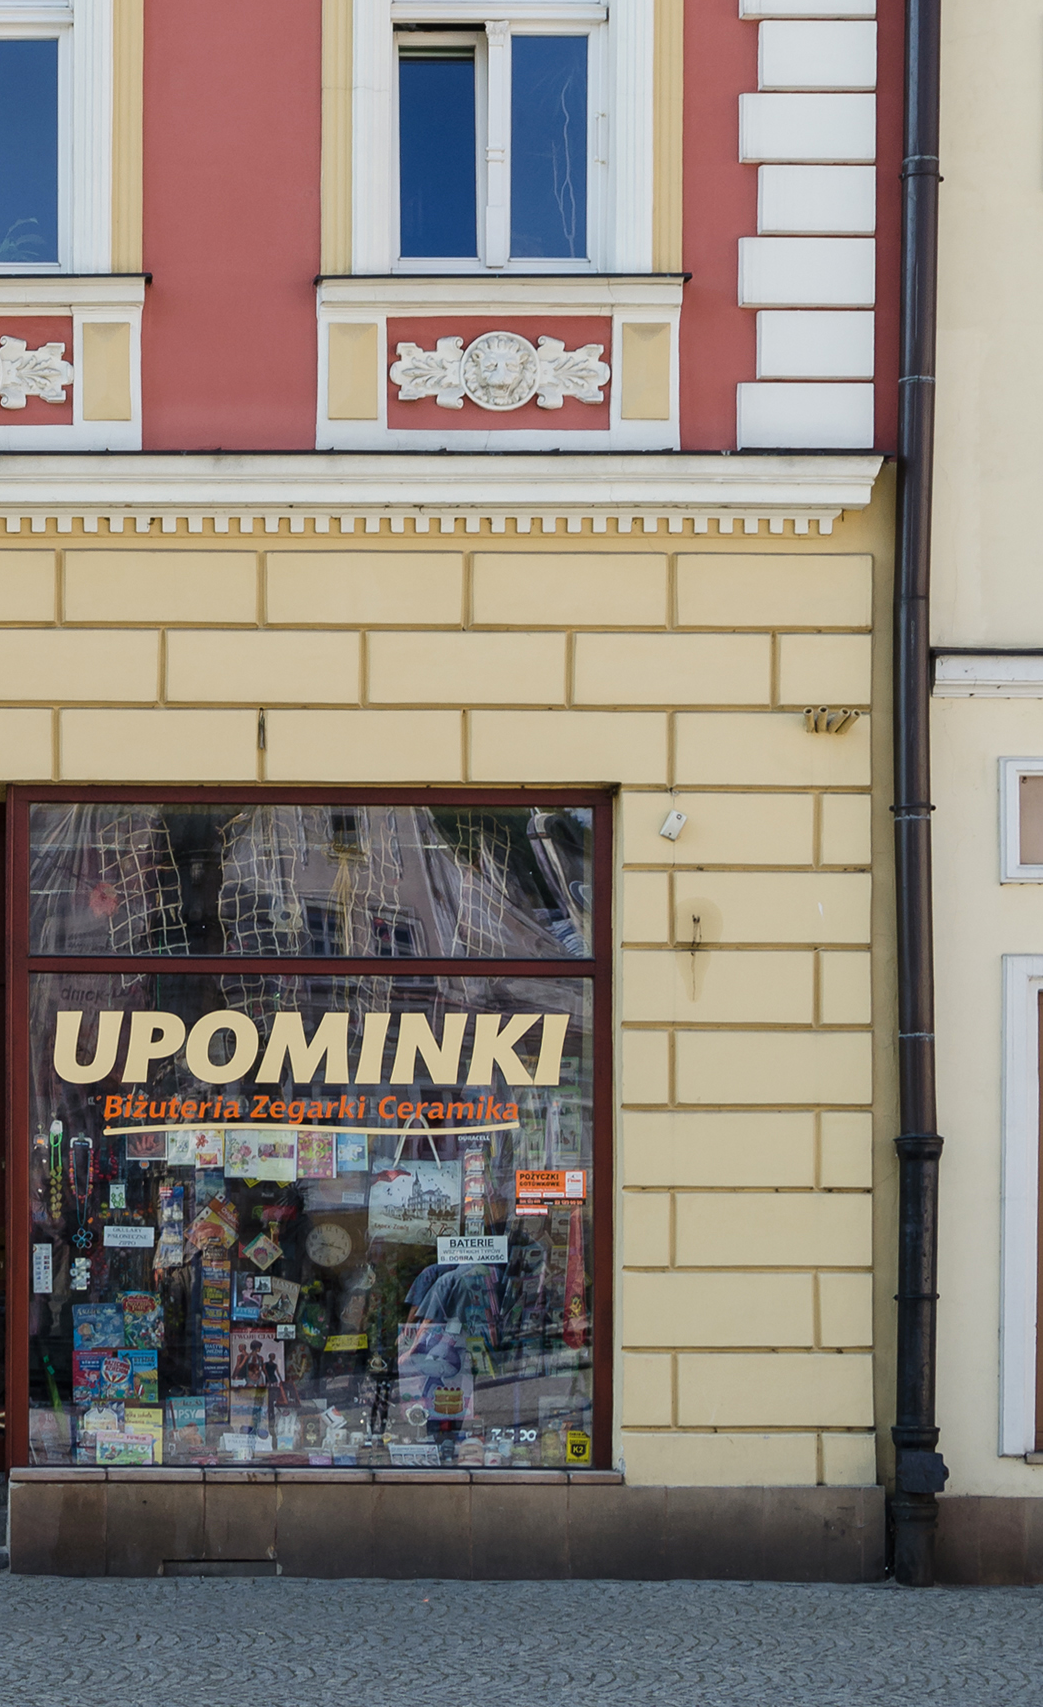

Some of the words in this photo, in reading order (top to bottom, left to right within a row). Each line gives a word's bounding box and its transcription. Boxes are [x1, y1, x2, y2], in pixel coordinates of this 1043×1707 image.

[53, 1010, 571, 1086] UPOMINKI
[104, 1094, 239, 1120] Biżuteria
[250, 1095, 366, 1125] Zegarki
[378, 1095, 519, 1120] Ceramika
[449, 1239, 494, 1248] BATERIE
[178, 1408, 196, 1419] PSY
[573, 1446, 584, 1454] K2
